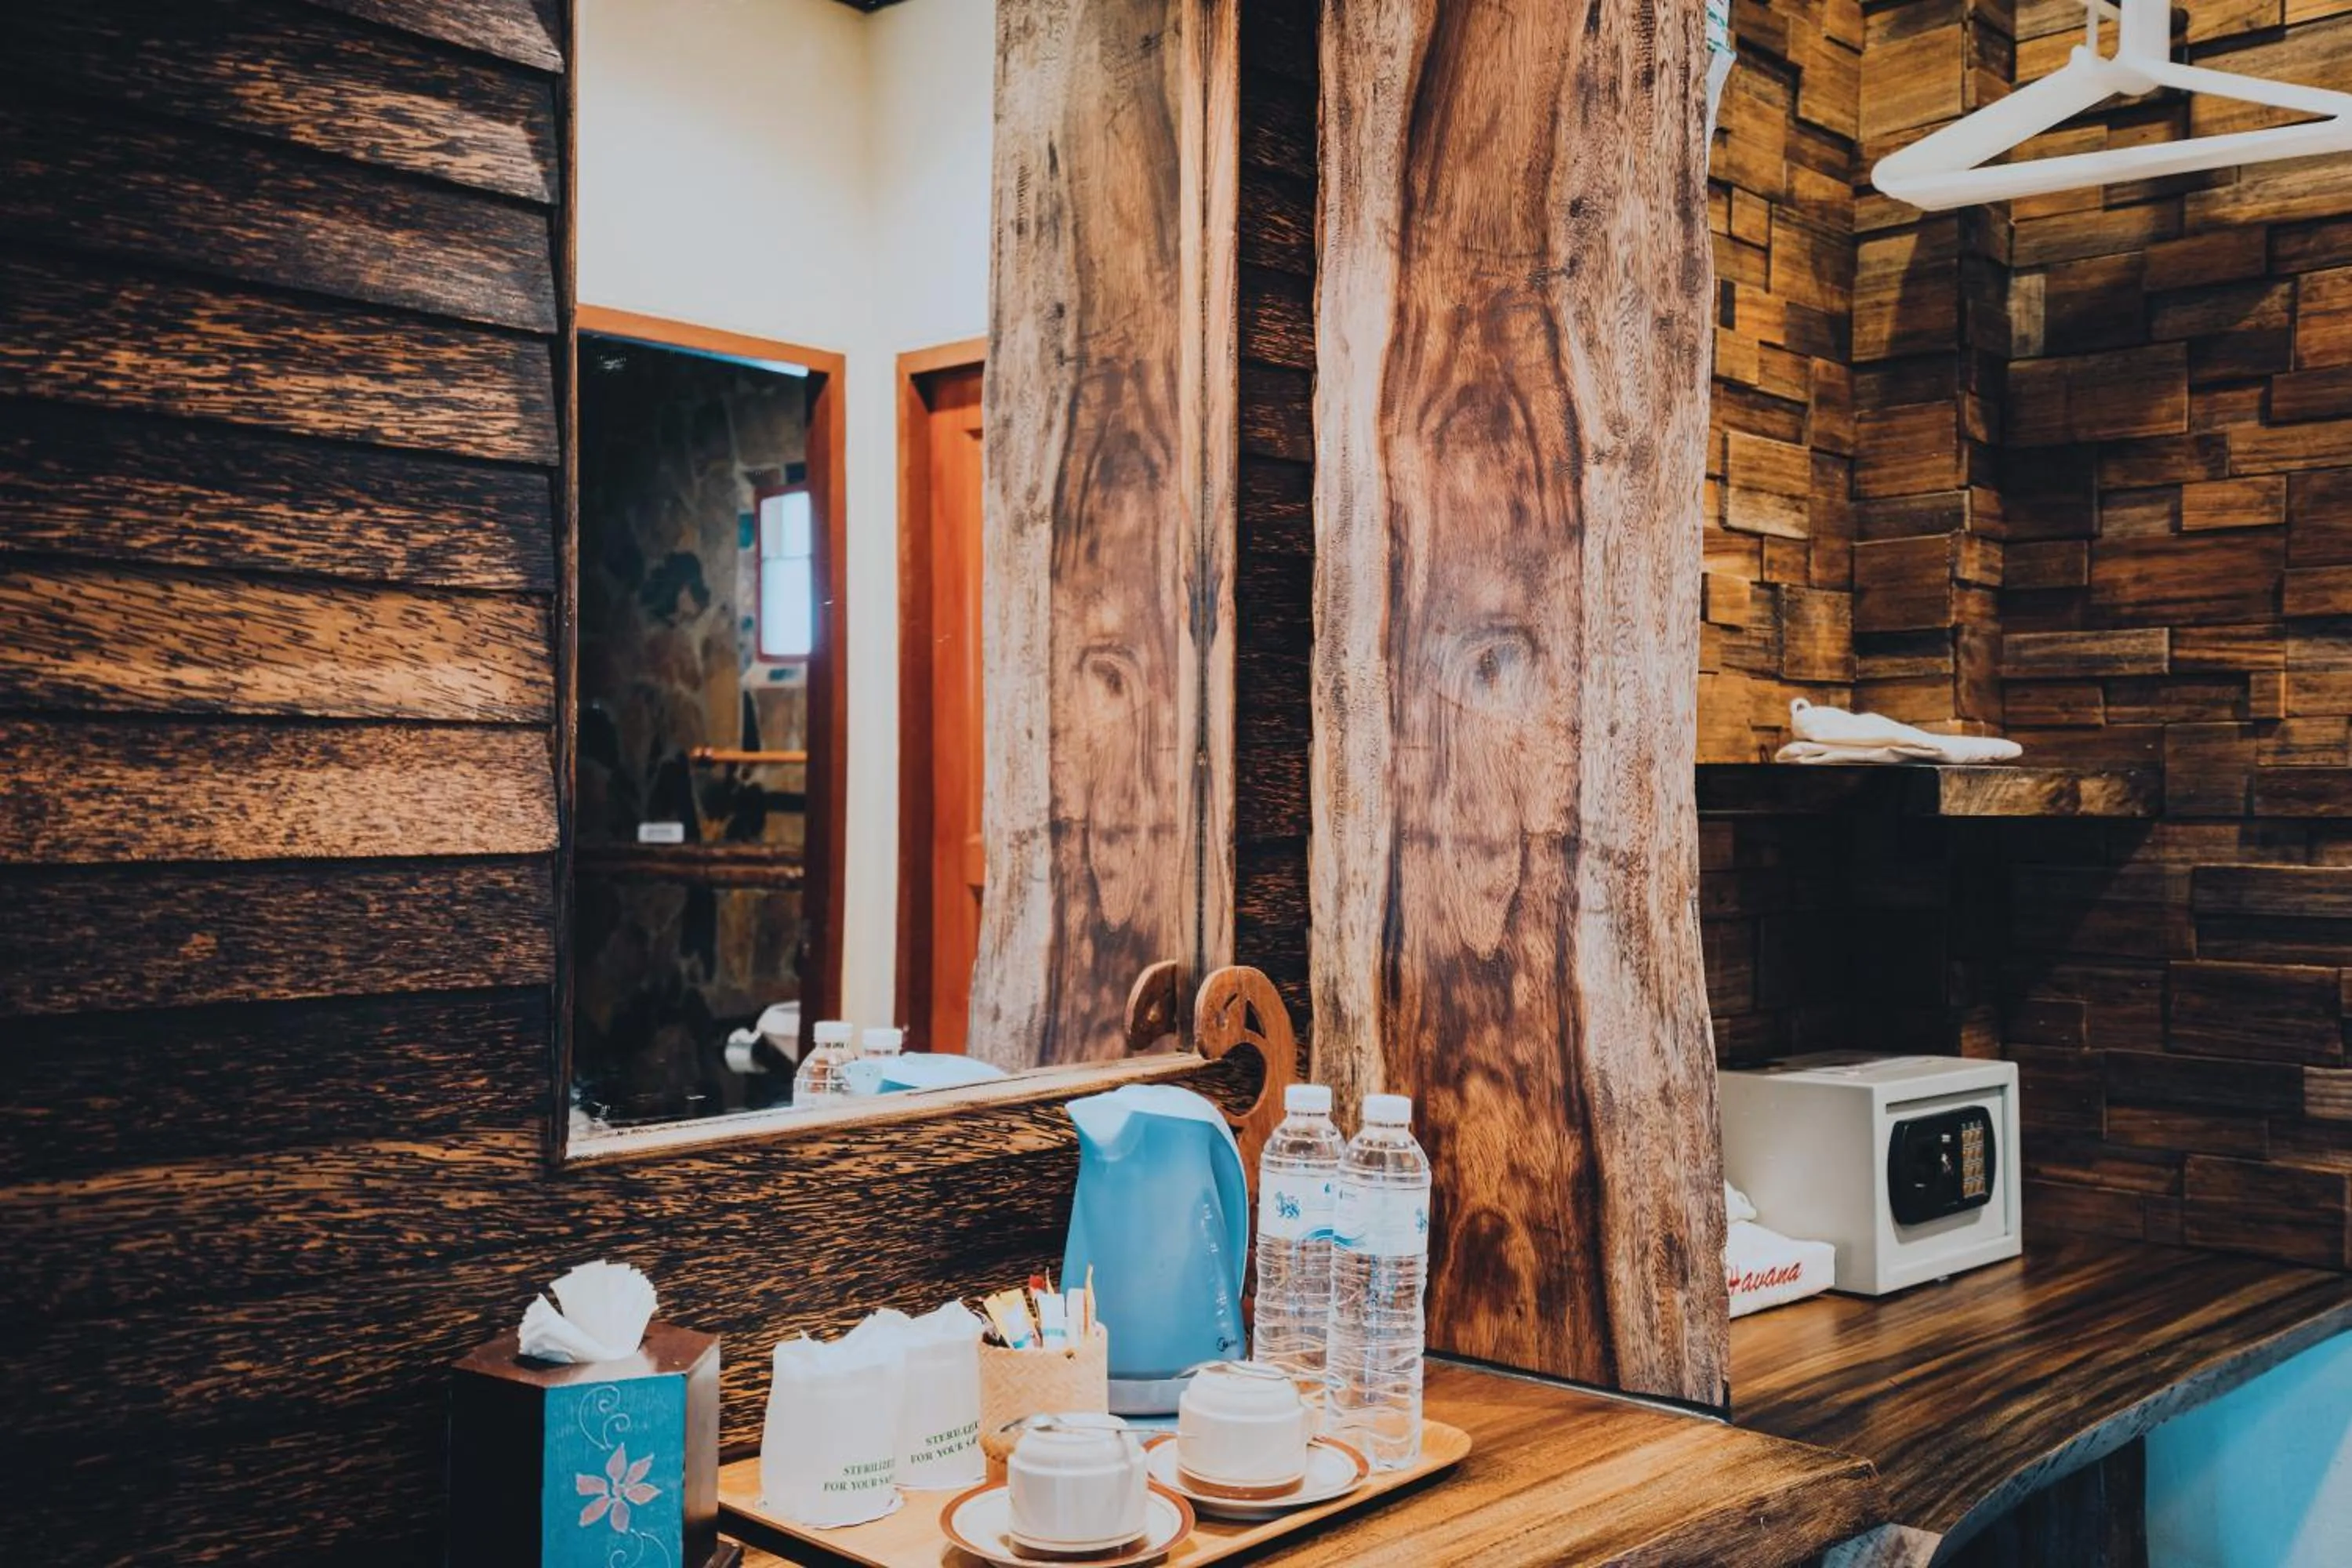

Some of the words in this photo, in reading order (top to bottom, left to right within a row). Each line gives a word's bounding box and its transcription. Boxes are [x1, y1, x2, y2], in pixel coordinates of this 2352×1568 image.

[910, 1453, 932, 1464] FOR
[936, 1442, 964, 1457] YOUR
[823, 1483, 847, 1491] FOR
[851, 1479, 877, 1490] YOUR
